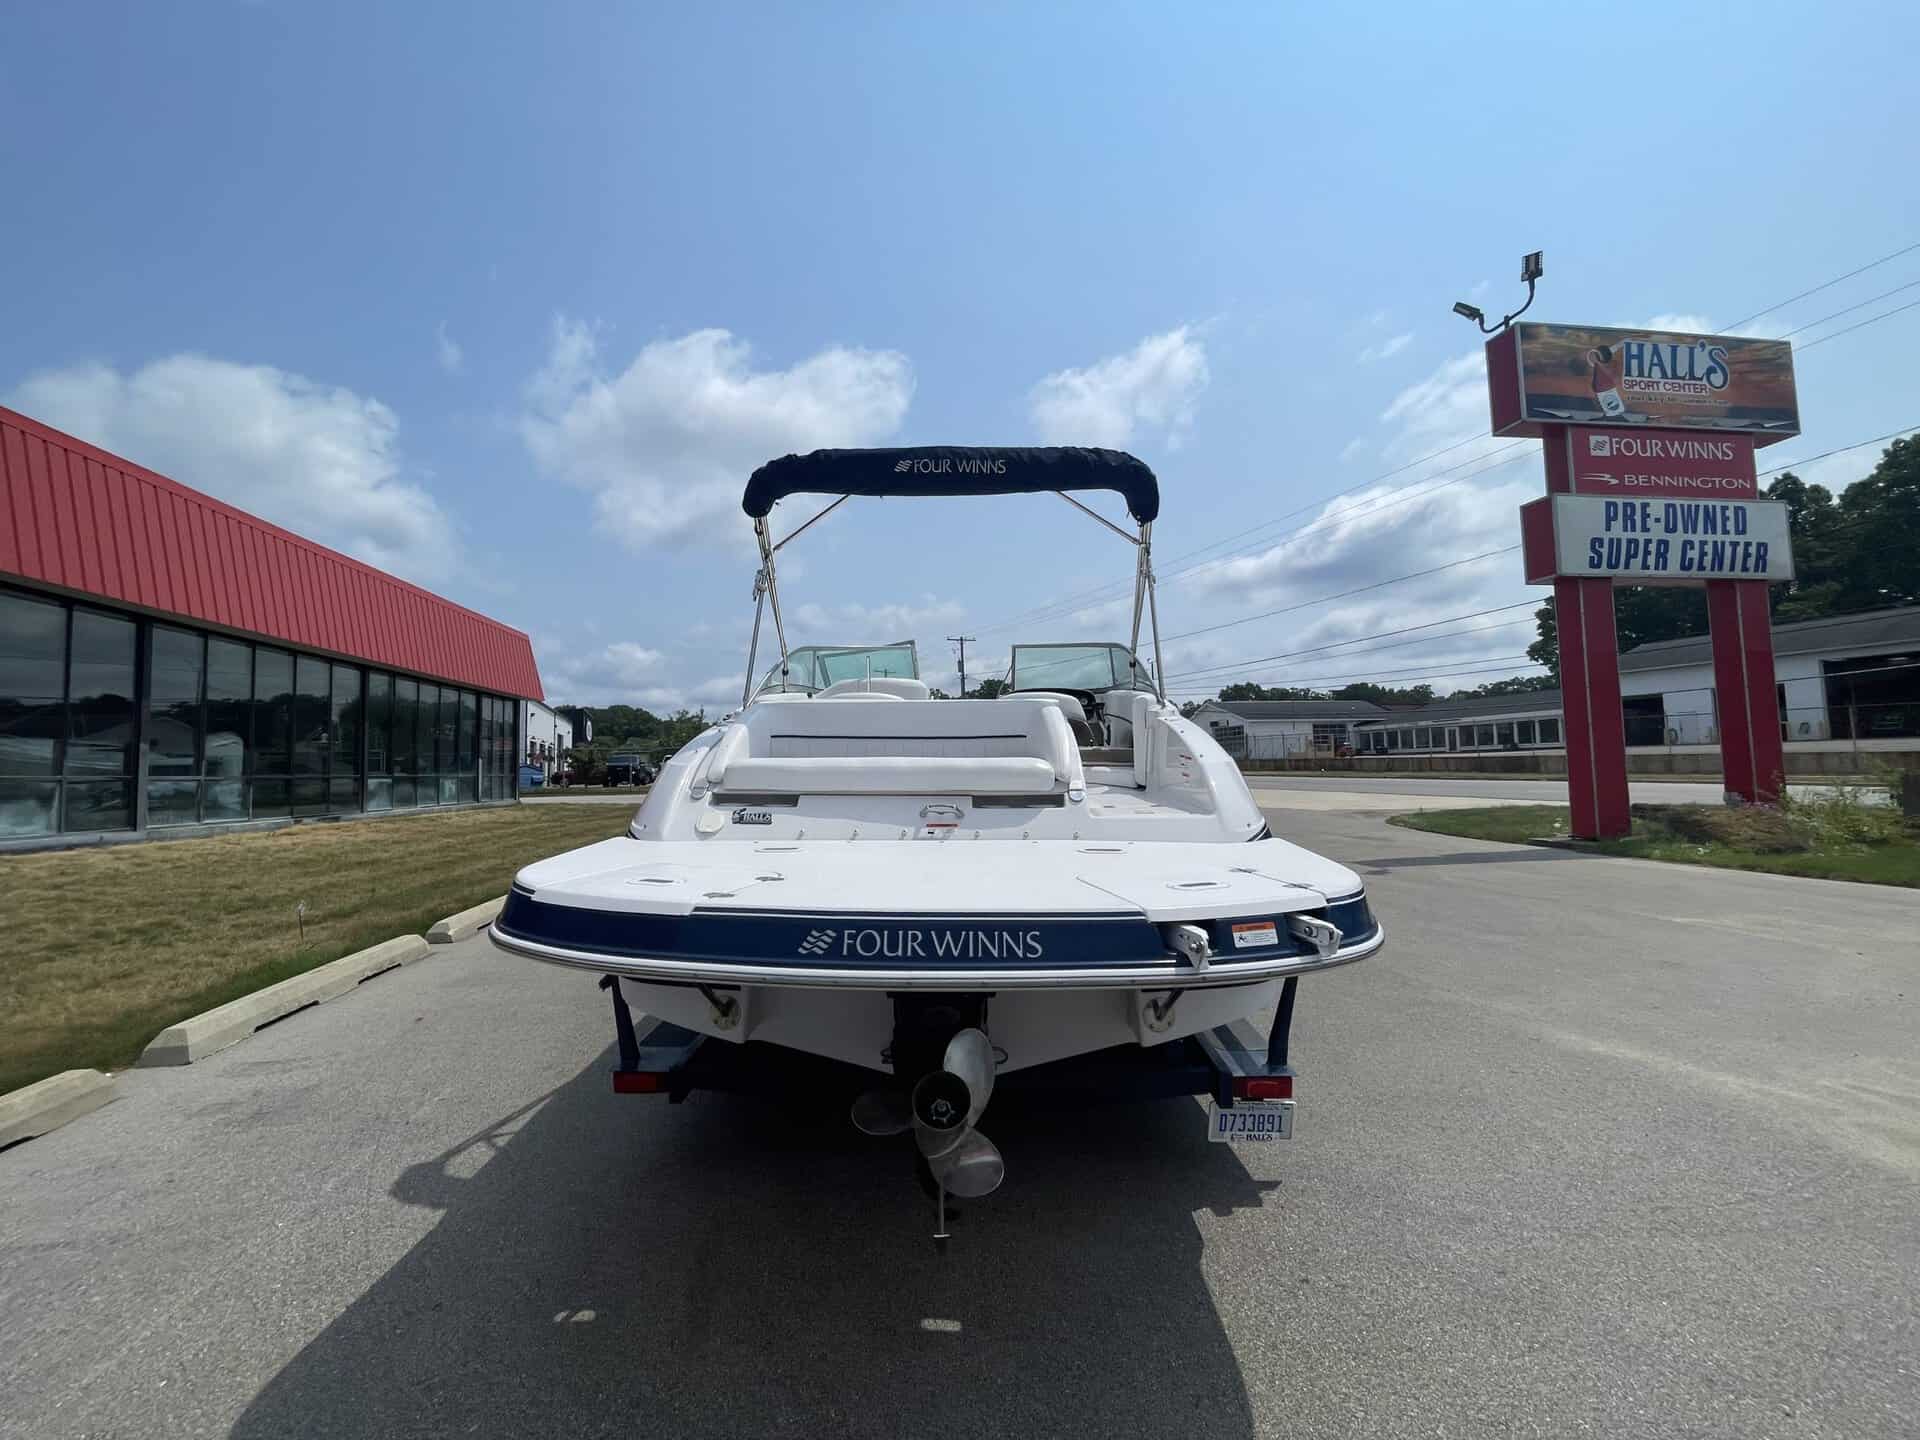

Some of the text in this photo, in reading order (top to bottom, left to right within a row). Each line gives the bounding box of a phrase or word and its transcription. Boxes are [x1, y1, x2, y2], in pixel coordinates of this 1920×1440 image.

[1623, 341, 1729, 389] HALL'S
[1623, 379, 1708, 394] SPORT CENTER
[1612, 437, 1734, 460] FOUR WINNS
[913, 458, 1007, 474] FOUR WINNS
[1624, 474, 1751, 489] BENNINGTON
[1604, 501, 1747, 535] PRE-OWNED
[1588, 536, 1769, 573] SUPER CENTER
[842, 929, 1043, 958] FOUR WINNS
